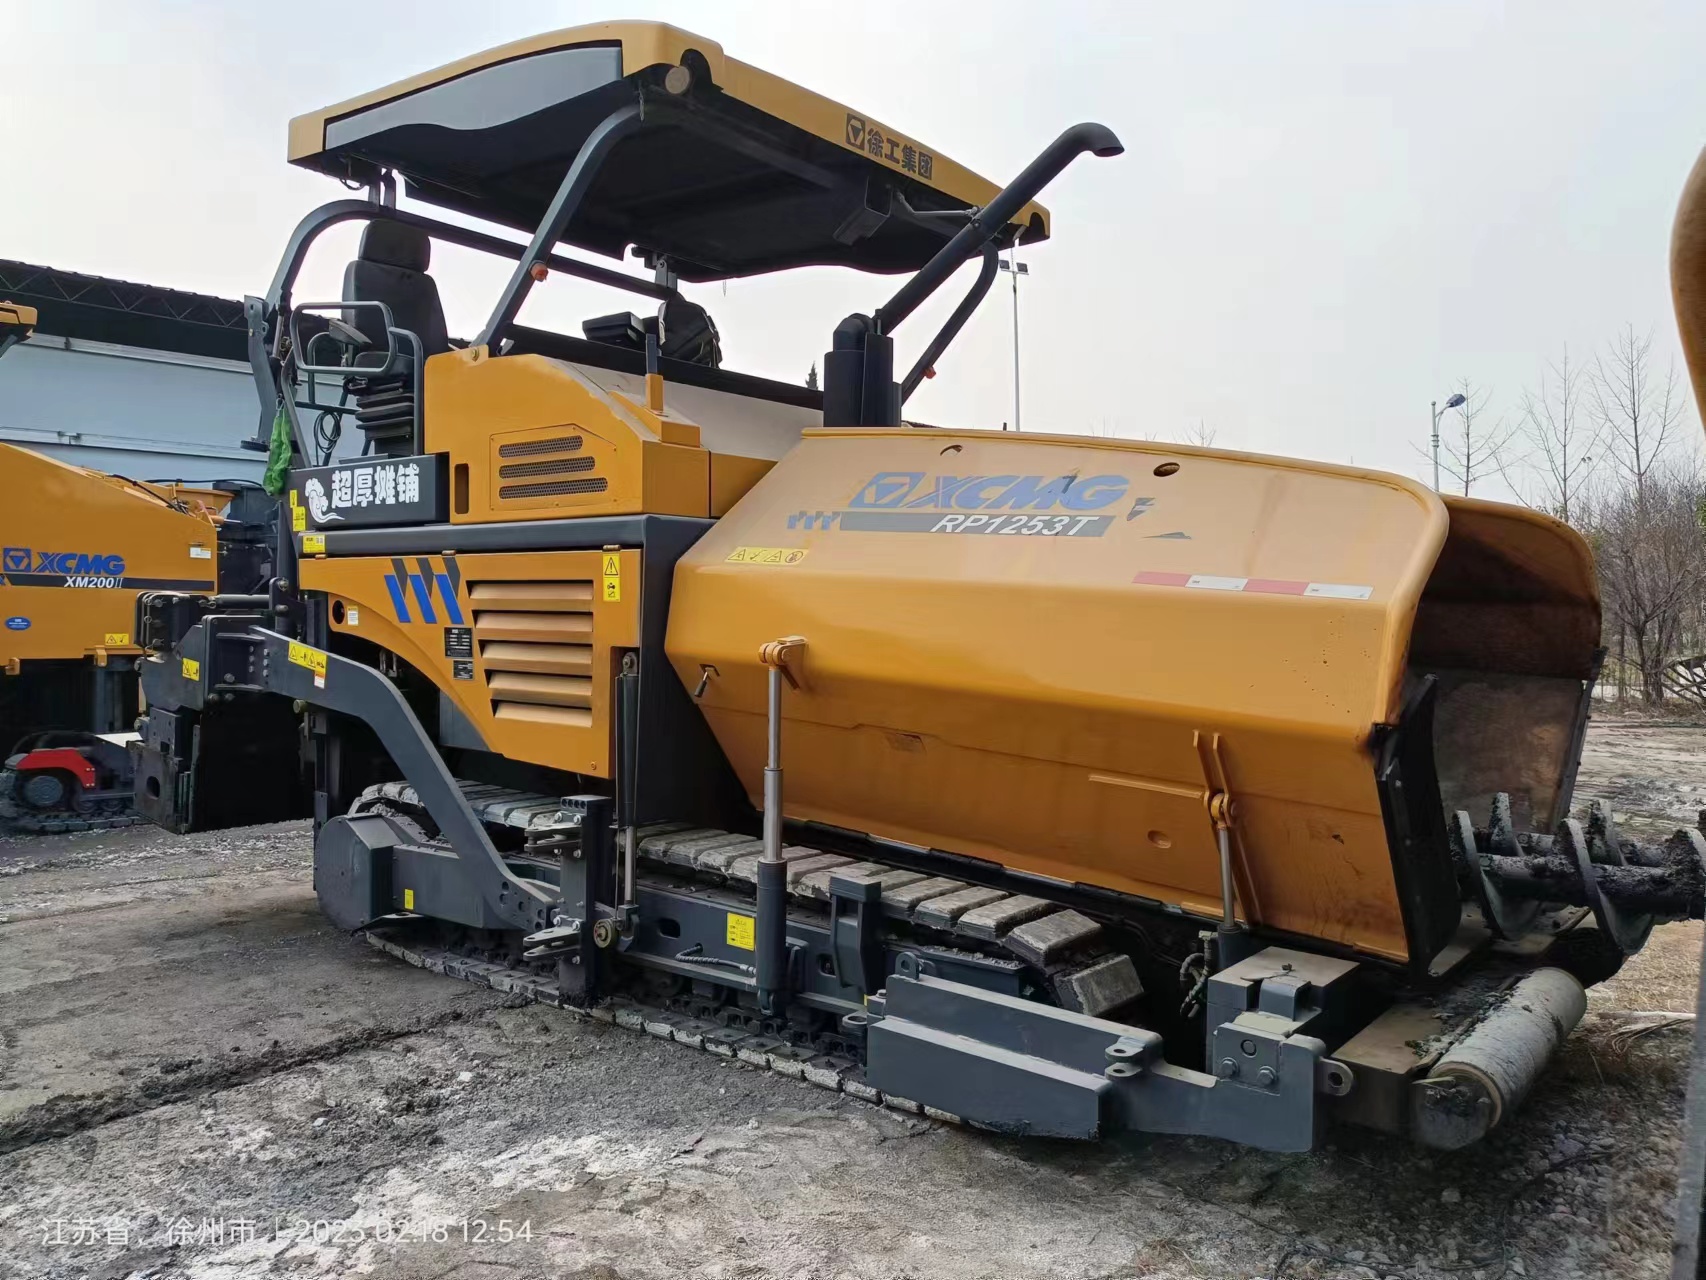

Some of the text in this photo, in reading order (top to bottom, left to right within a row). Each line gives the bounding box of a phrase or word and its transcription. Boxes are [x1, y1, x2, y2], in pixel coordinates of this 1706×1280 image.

[866, 127, 932, 181] 徐工集团
[331, 462, 420, 509] 超厚摊铺
[903, 475, 1130, 510] XCMG
[929, 514, 1100, 536] RP1253T
[33, 551, 126, 576] XCMG
